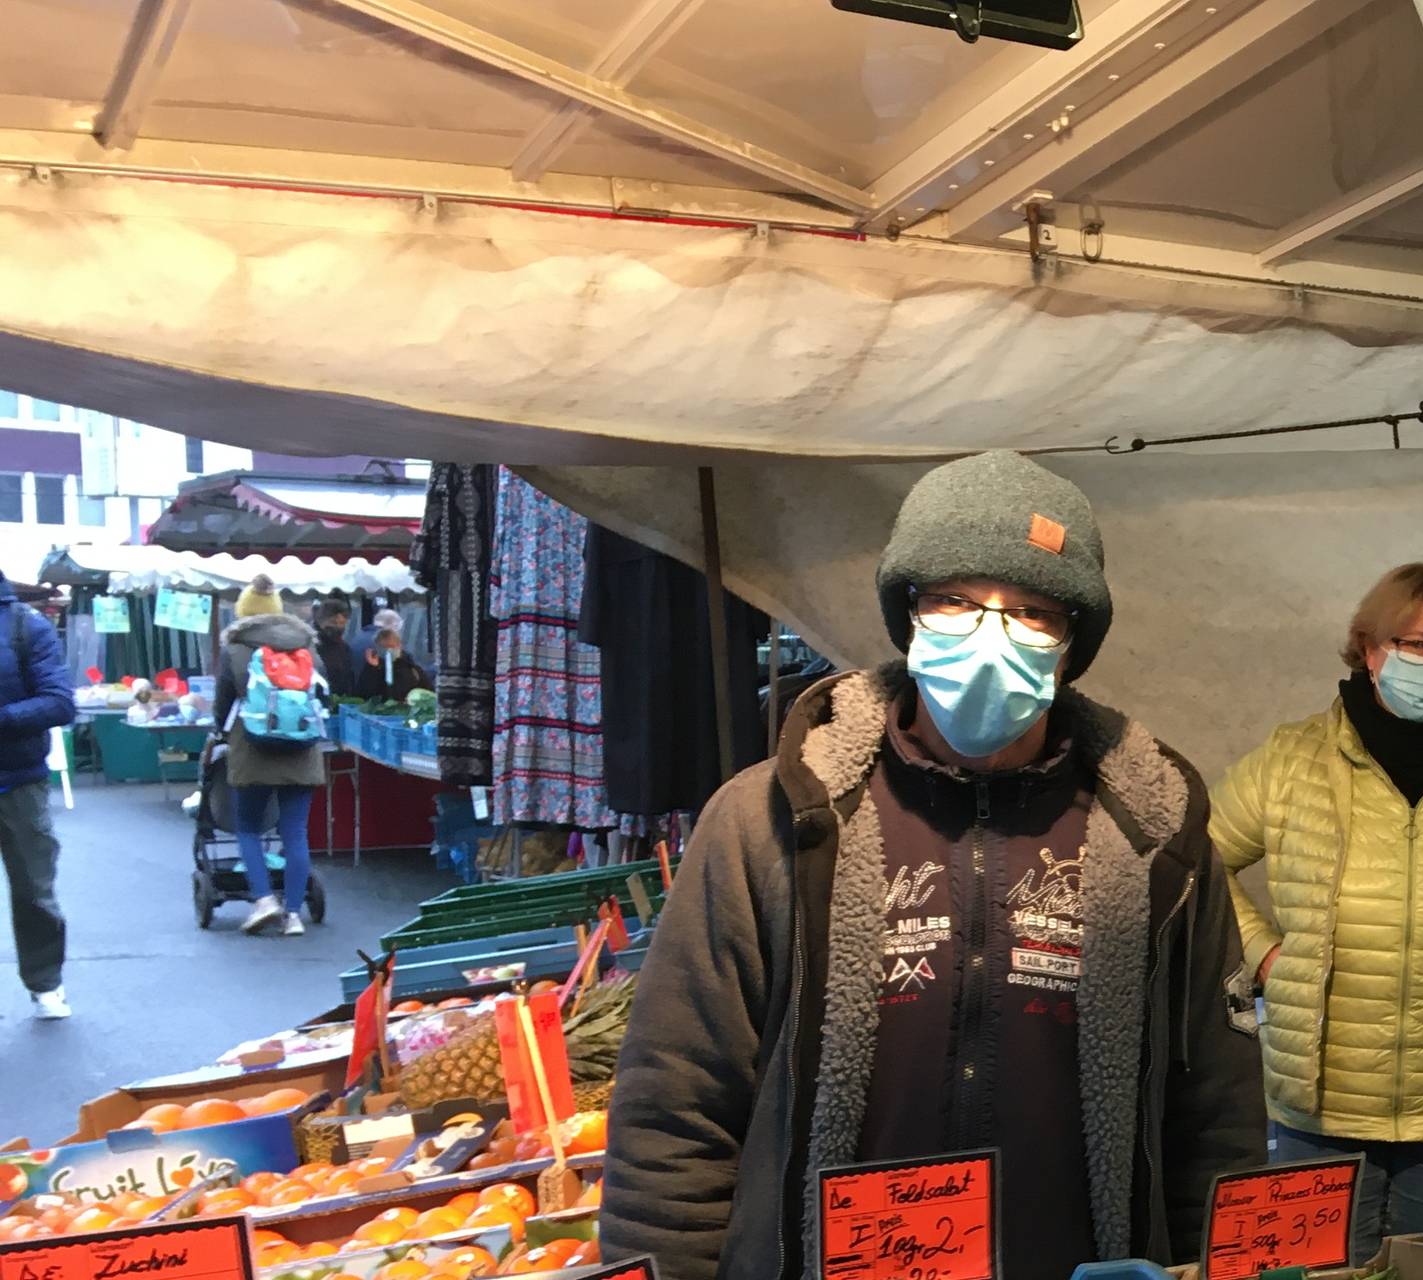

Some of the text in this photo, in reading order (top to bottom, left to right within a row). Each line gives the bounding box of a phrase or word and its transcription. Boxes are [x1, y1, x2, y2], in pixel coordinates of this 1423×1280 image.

[897, 916, 951, 935] MILES
[1019, 954, 1077, 973] SAIL PORT
[1006, 972, 1078, 992] GEOGRAPHIC
